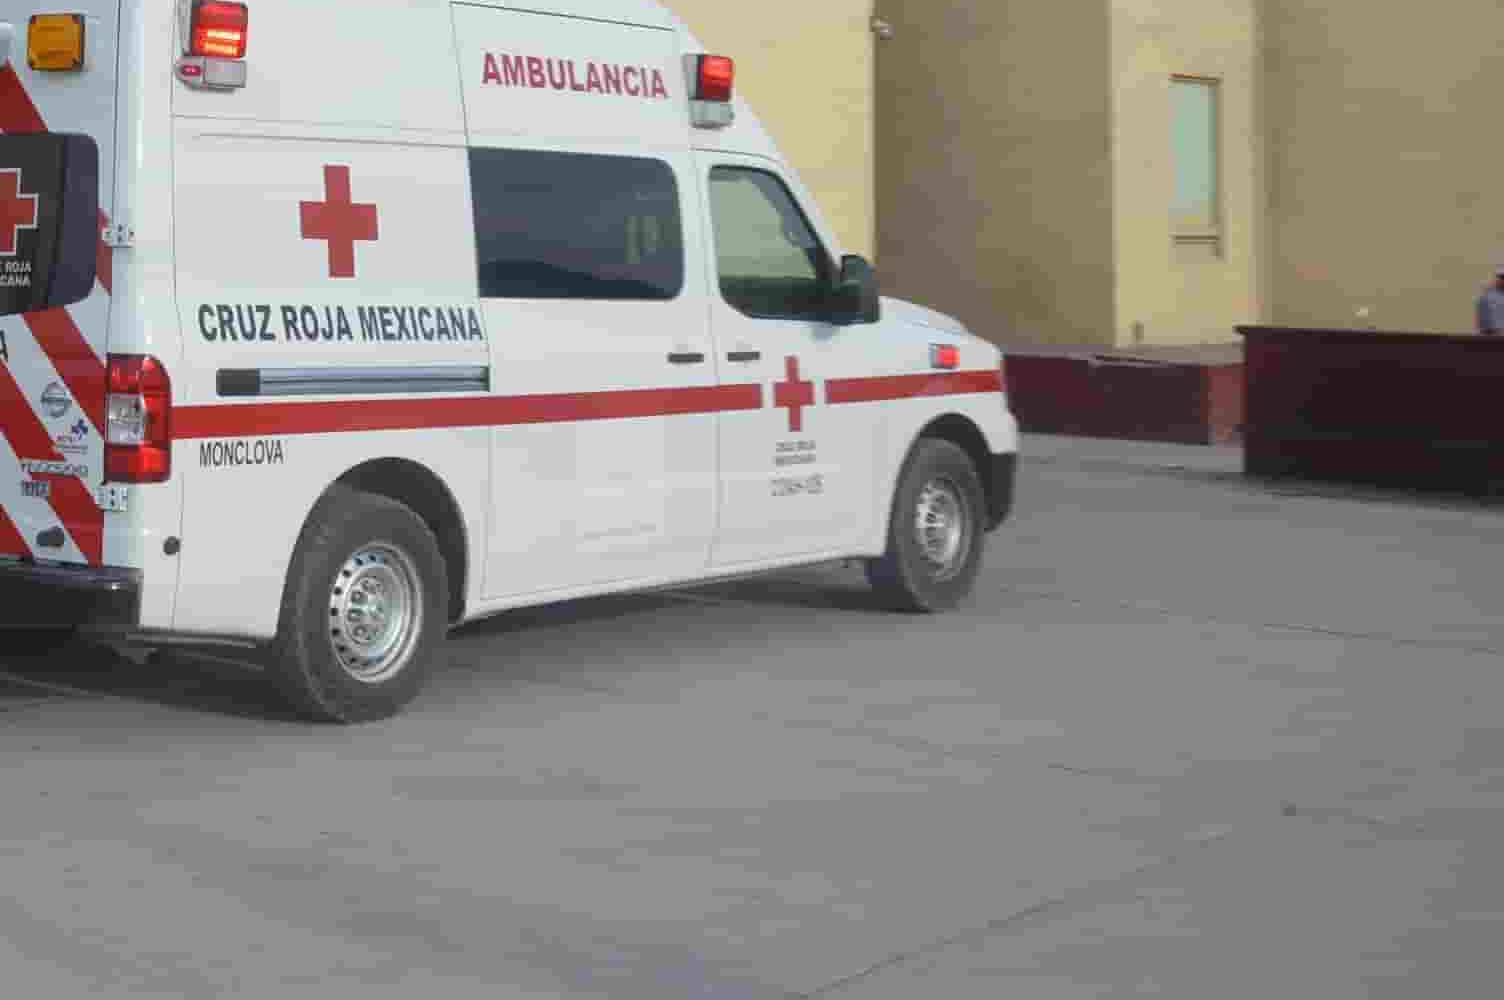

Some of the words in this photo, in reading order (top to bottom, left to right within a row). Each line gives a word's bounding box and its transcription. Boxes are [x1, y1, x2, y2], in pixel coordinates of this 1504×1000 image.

[481, 53, 668, 98] AMBULANCIA
[5, 261, 32, 273] ROJA
[198, 303, 276, 342] CRUZ
[283, 304, 353, 342] ROJA
[357, 305, 484, 342] MEXICANA
[199, 439, 284, 467] MONCLOVA
